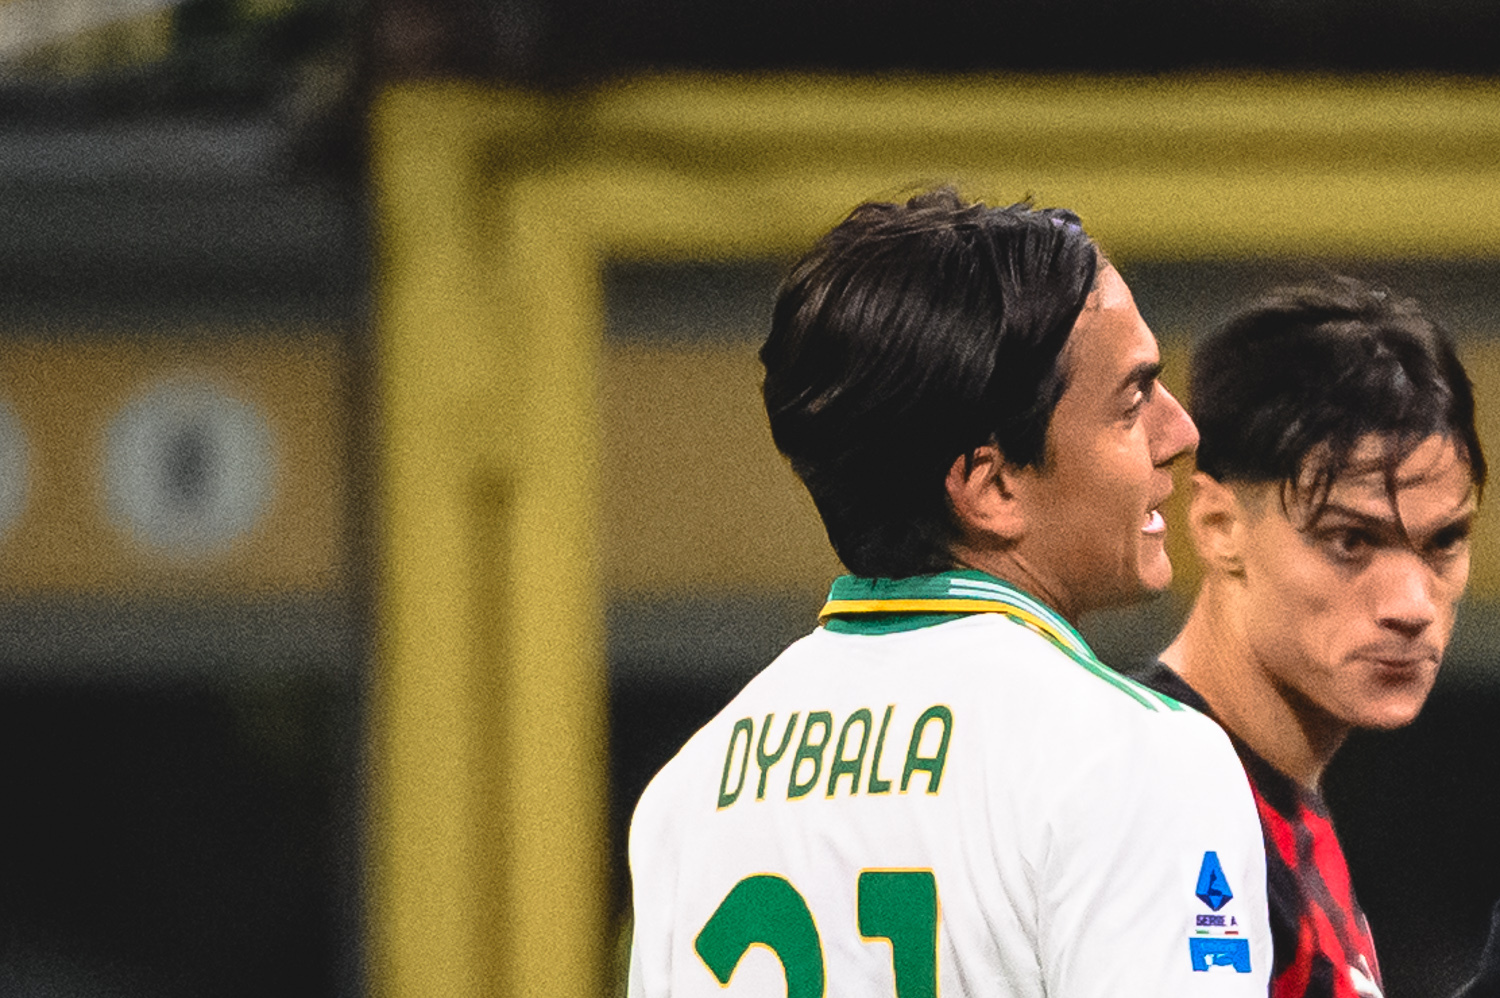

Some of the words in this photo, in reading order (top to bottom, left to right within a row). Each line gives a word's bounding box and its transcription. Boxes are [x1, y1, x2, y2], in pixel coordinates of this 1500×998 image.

[717, 704, 954, 811] DYBALA
[1196, 914, 1226, 927] SERIE
[1229, 915, 1238, 927] A
